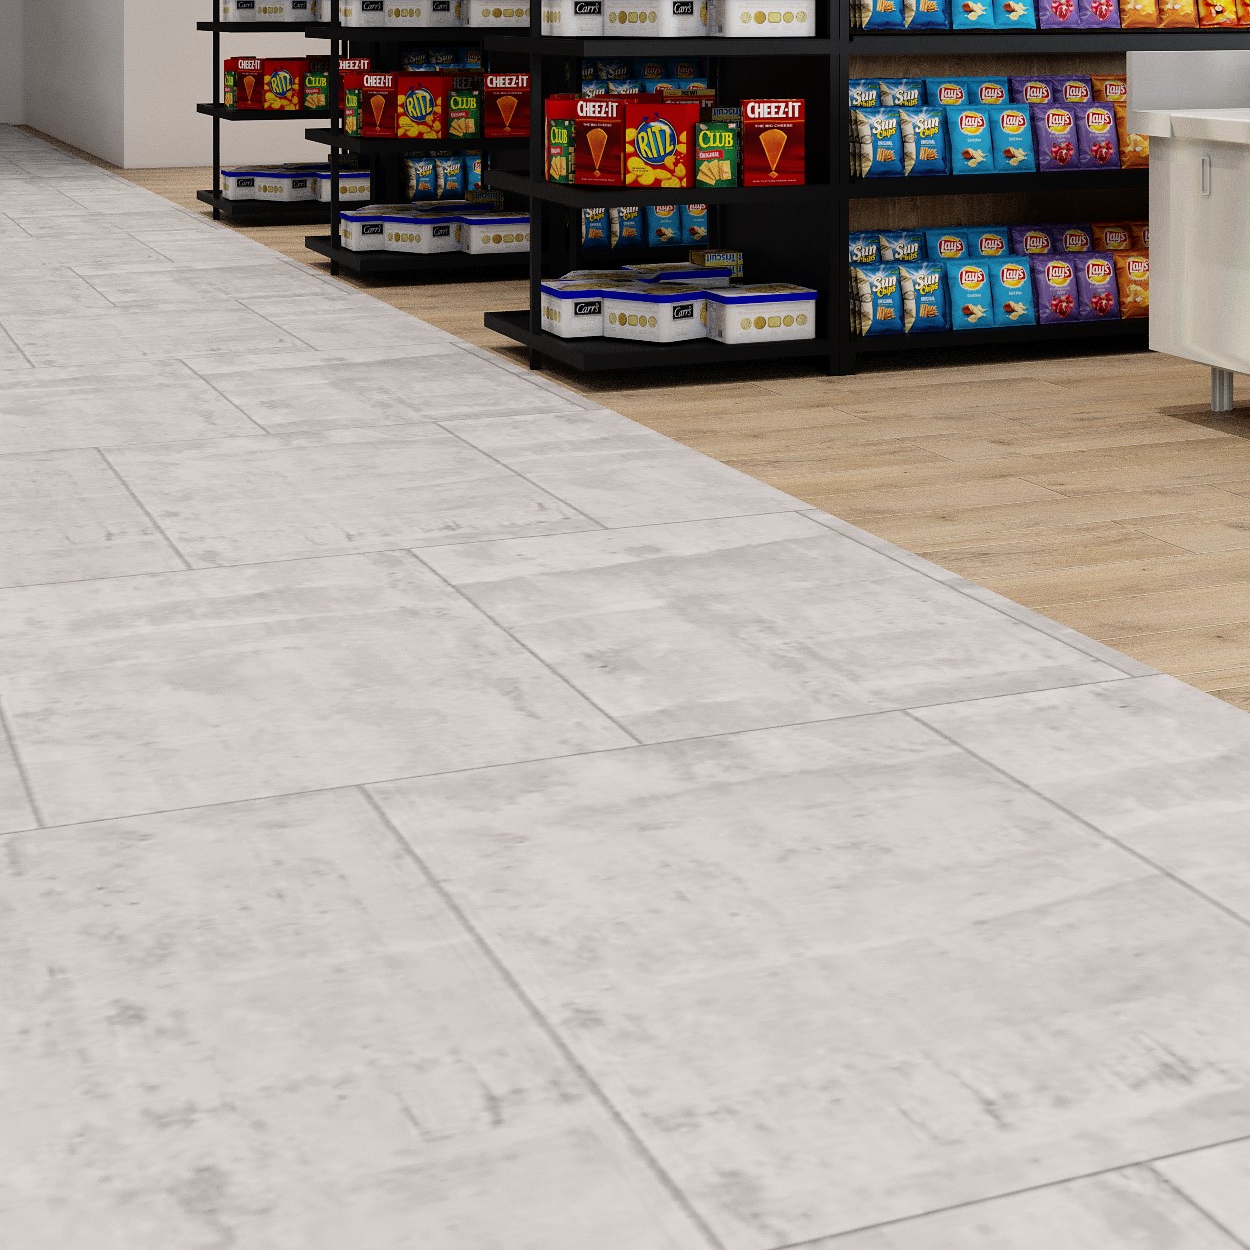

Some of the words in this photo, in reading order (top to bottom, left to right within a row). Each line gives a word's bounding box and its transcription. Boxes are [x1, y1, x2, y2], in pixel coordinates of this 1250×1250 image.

[576, 2, 599, 13] Carr's
[674, 2, 691, 13] Carr's
[339, 60, 369, 70] HEEZ-IT
[271, 73, 292, 94] RITZ
[306, 76, 327, 87] CLUB
[364, 75, 393, 88] CHEEZ-IT
[487, 75, 528, 88] CHEEZ-IT
[450, 96, 477, 109] CLUB
[853, 87, 877, 103] Sun
[895, 88, 919, 103] Sun
[407, 92, 432, 117] RITZ
[577, 101, 618, 117] CHEEZ-IT
[747, 102, 801, 118] CHEEZ-IT
[872, 117, 897, 133] Sun
[916, 117, 939, 133] Sun
[961, 114, 985, 129] Lay's
[1002, 113, 1027, 128] Lay's
[1048, 111, 1072, 127] Lay's
[1088, 110, 1112, 126] Lay's
[638, 125, 674, 158] RITZ
[698, 131, 733, 148] CLUB
[1048, 264, 1072, 279] Lay's
[1088, 262, 1112, 277] Lay's
[1128, 259, 1149, 273] Lay's
[872, 273, 897, 289] Sun
[916, 271, 939, 287] Sun
[961, 269, 985, 285] Lay's
[1002, 267, 1027, 282] Lay's
[576, 302, 599, 314] Carr's
[673, 305, 692, 317] Carr's
